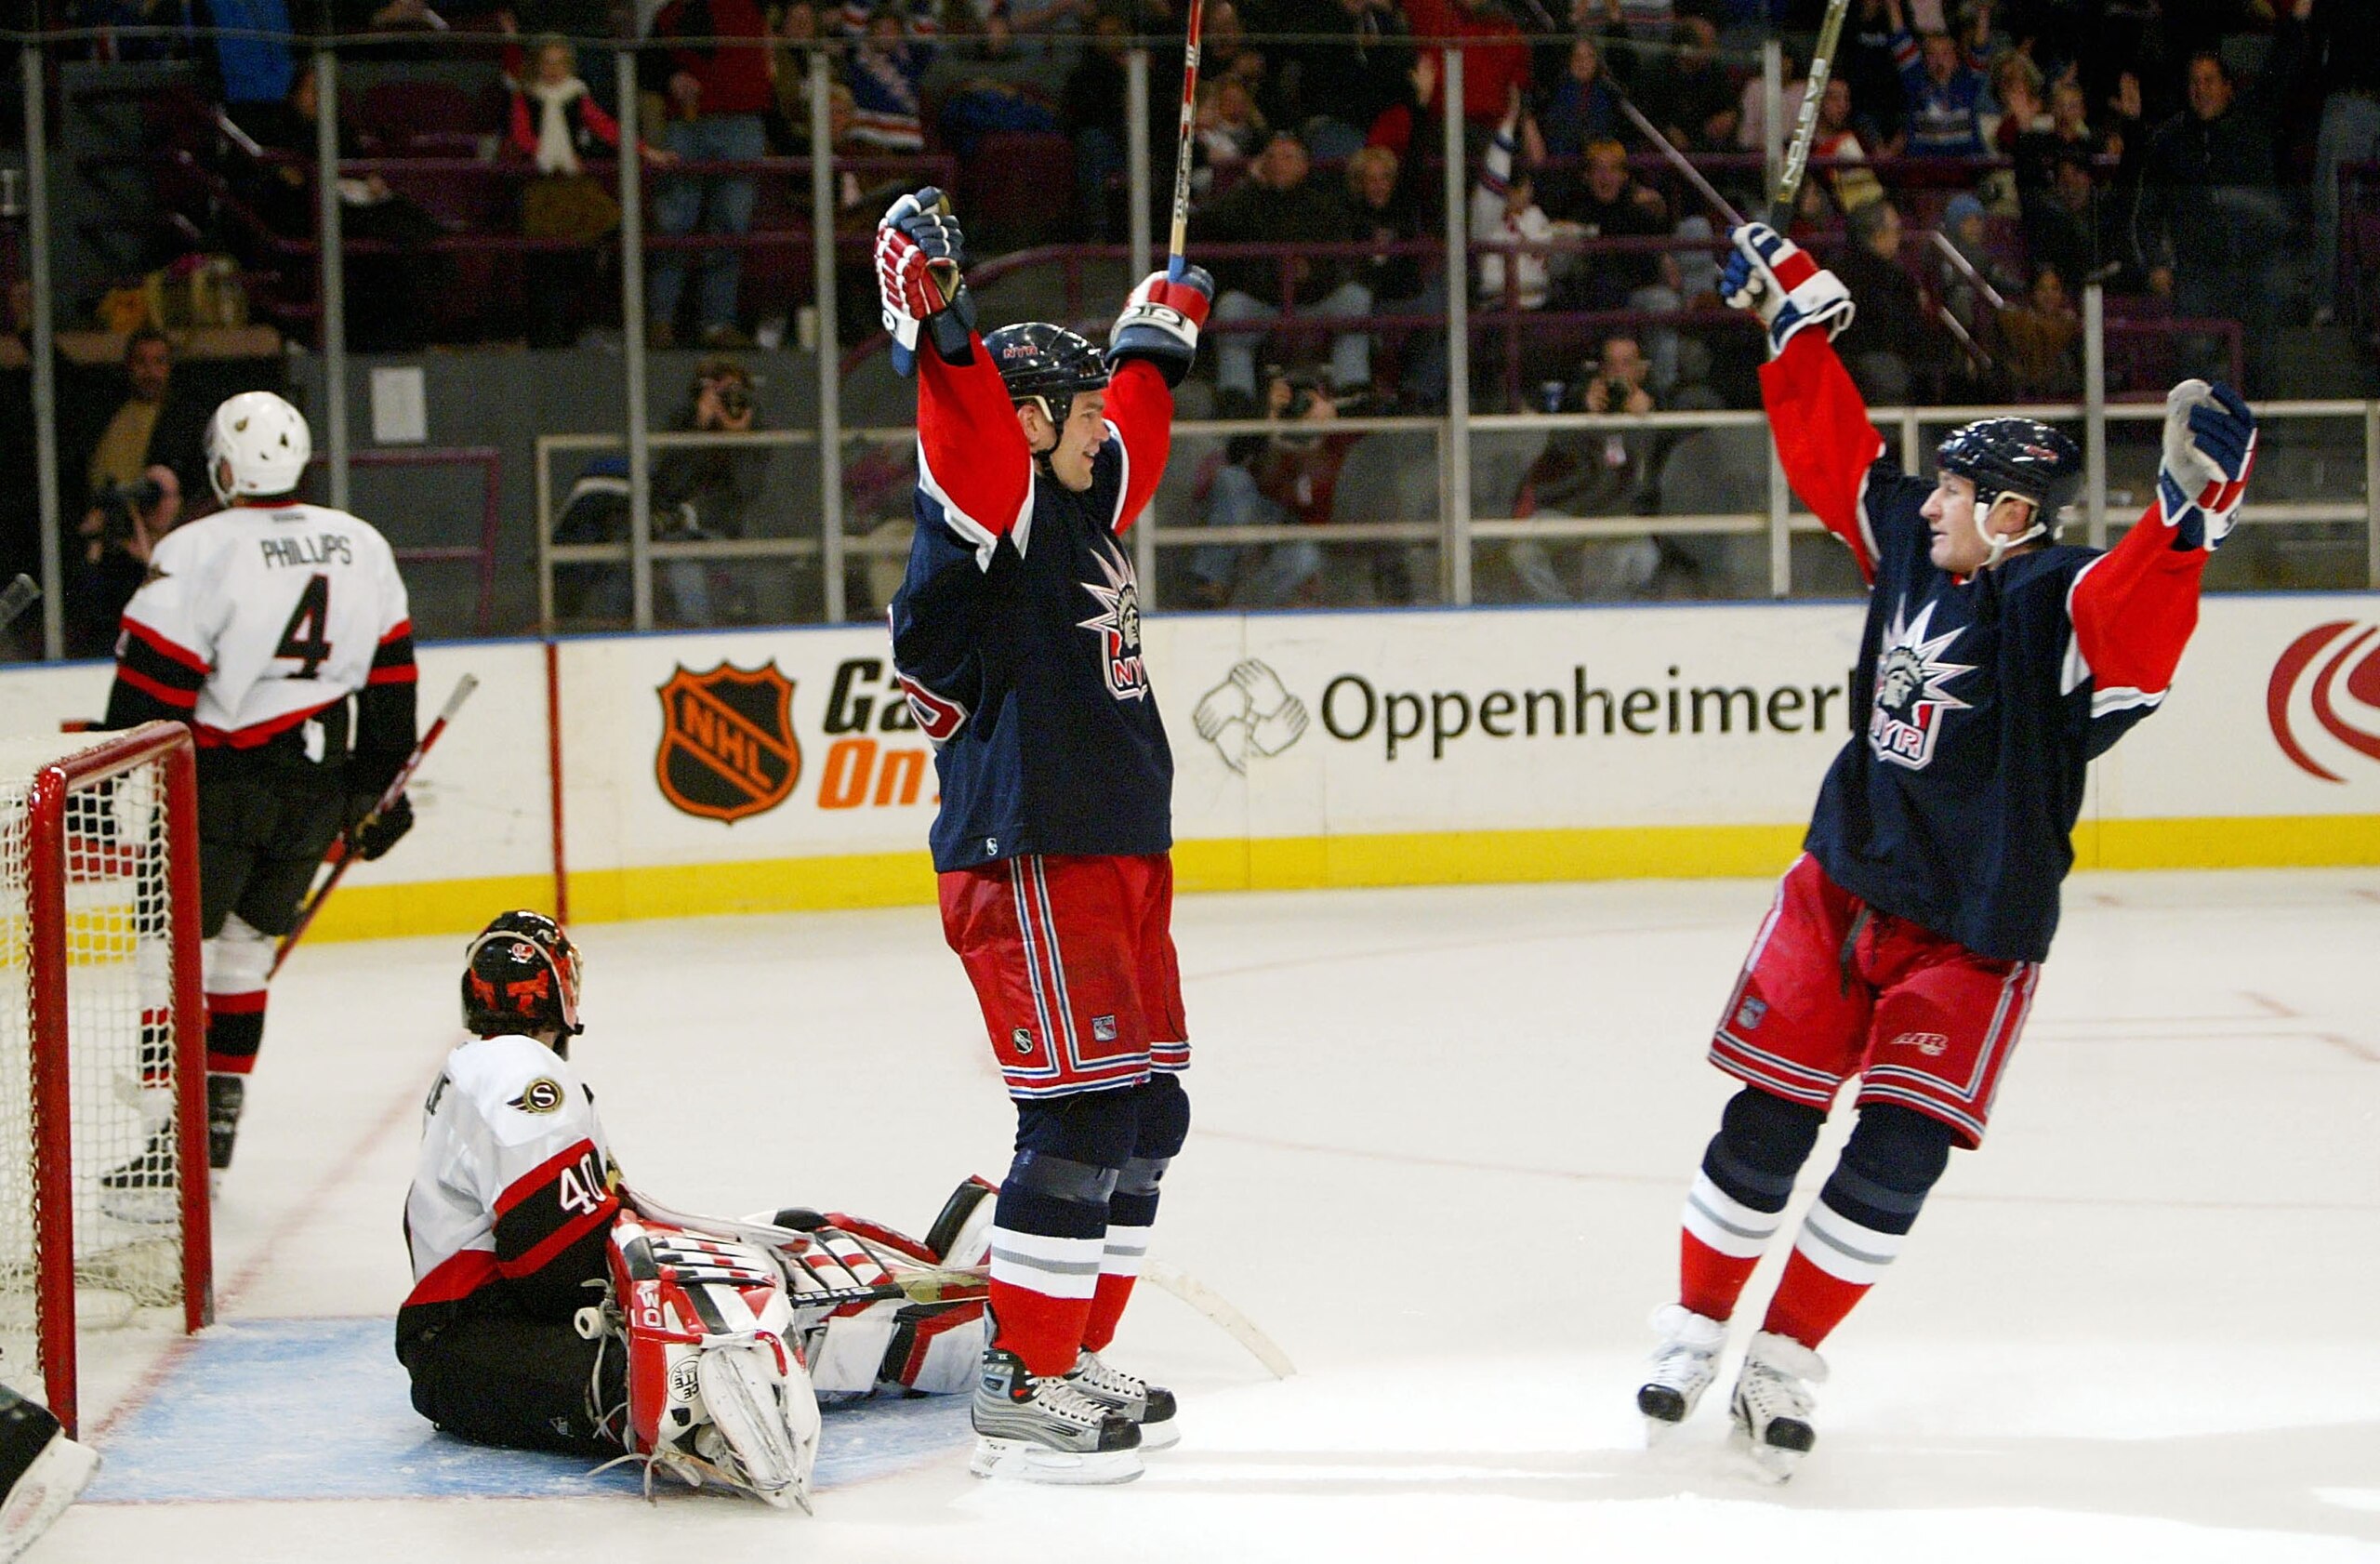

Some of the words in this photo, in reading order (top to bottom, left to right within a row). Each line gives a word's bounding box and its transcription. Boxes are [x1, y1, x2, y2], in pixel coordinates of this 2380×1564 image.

[1780, 58, 1827, 184] EASTON
[260, 533, 352, 569] PHILLIPS
[273, 574, 334, 680] 4
[1112, 654, 1146, 687] NY
[681, 692, 775, 792] NHL
[560, 1153, 606, 1216] 40
